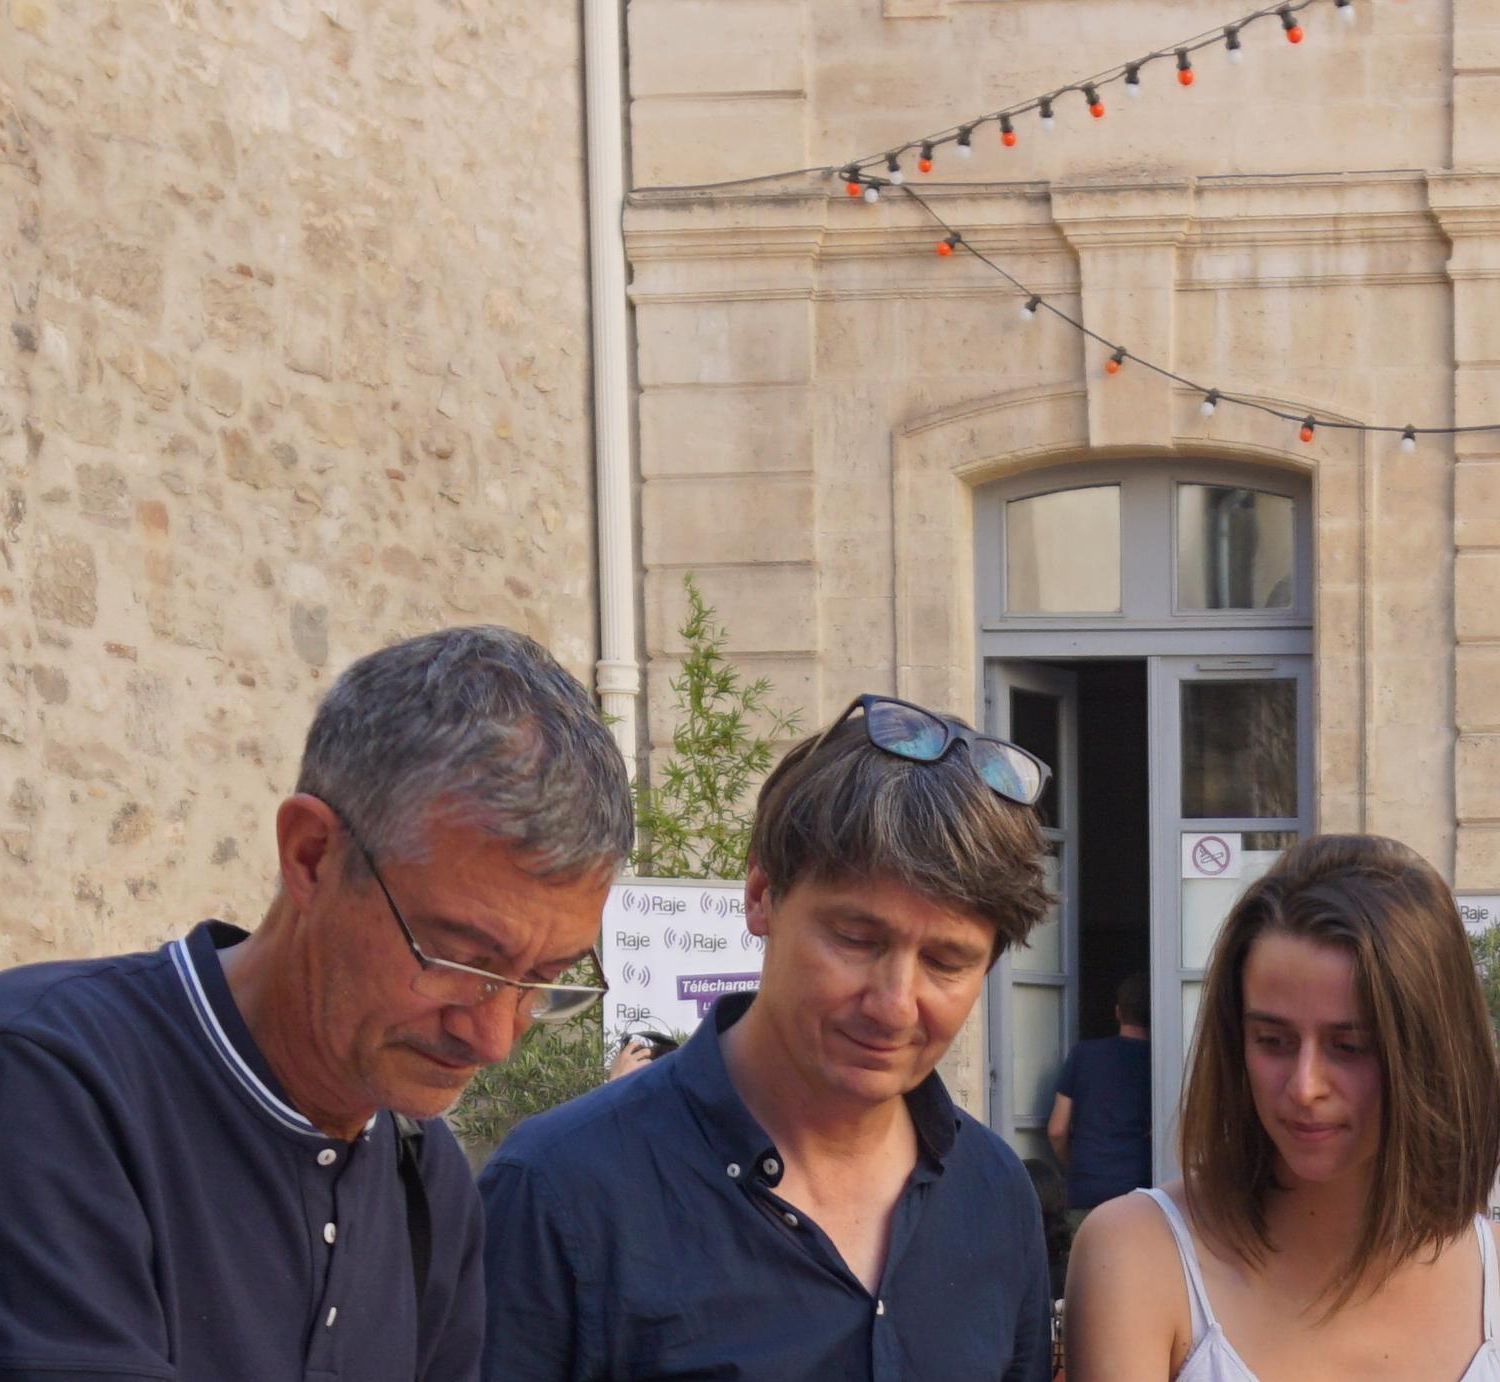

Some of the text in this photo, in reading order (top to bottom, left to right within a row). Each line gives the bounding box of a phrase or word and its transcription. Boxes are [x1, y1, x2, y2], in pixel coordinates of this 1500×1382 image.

[652, 896, 746, 914] Raje Ra
[1460, 905, 1489, 922] Raje
[615, 931, 727, 951] Raje Raje
[616, 1003, 650, 1021] Raje
